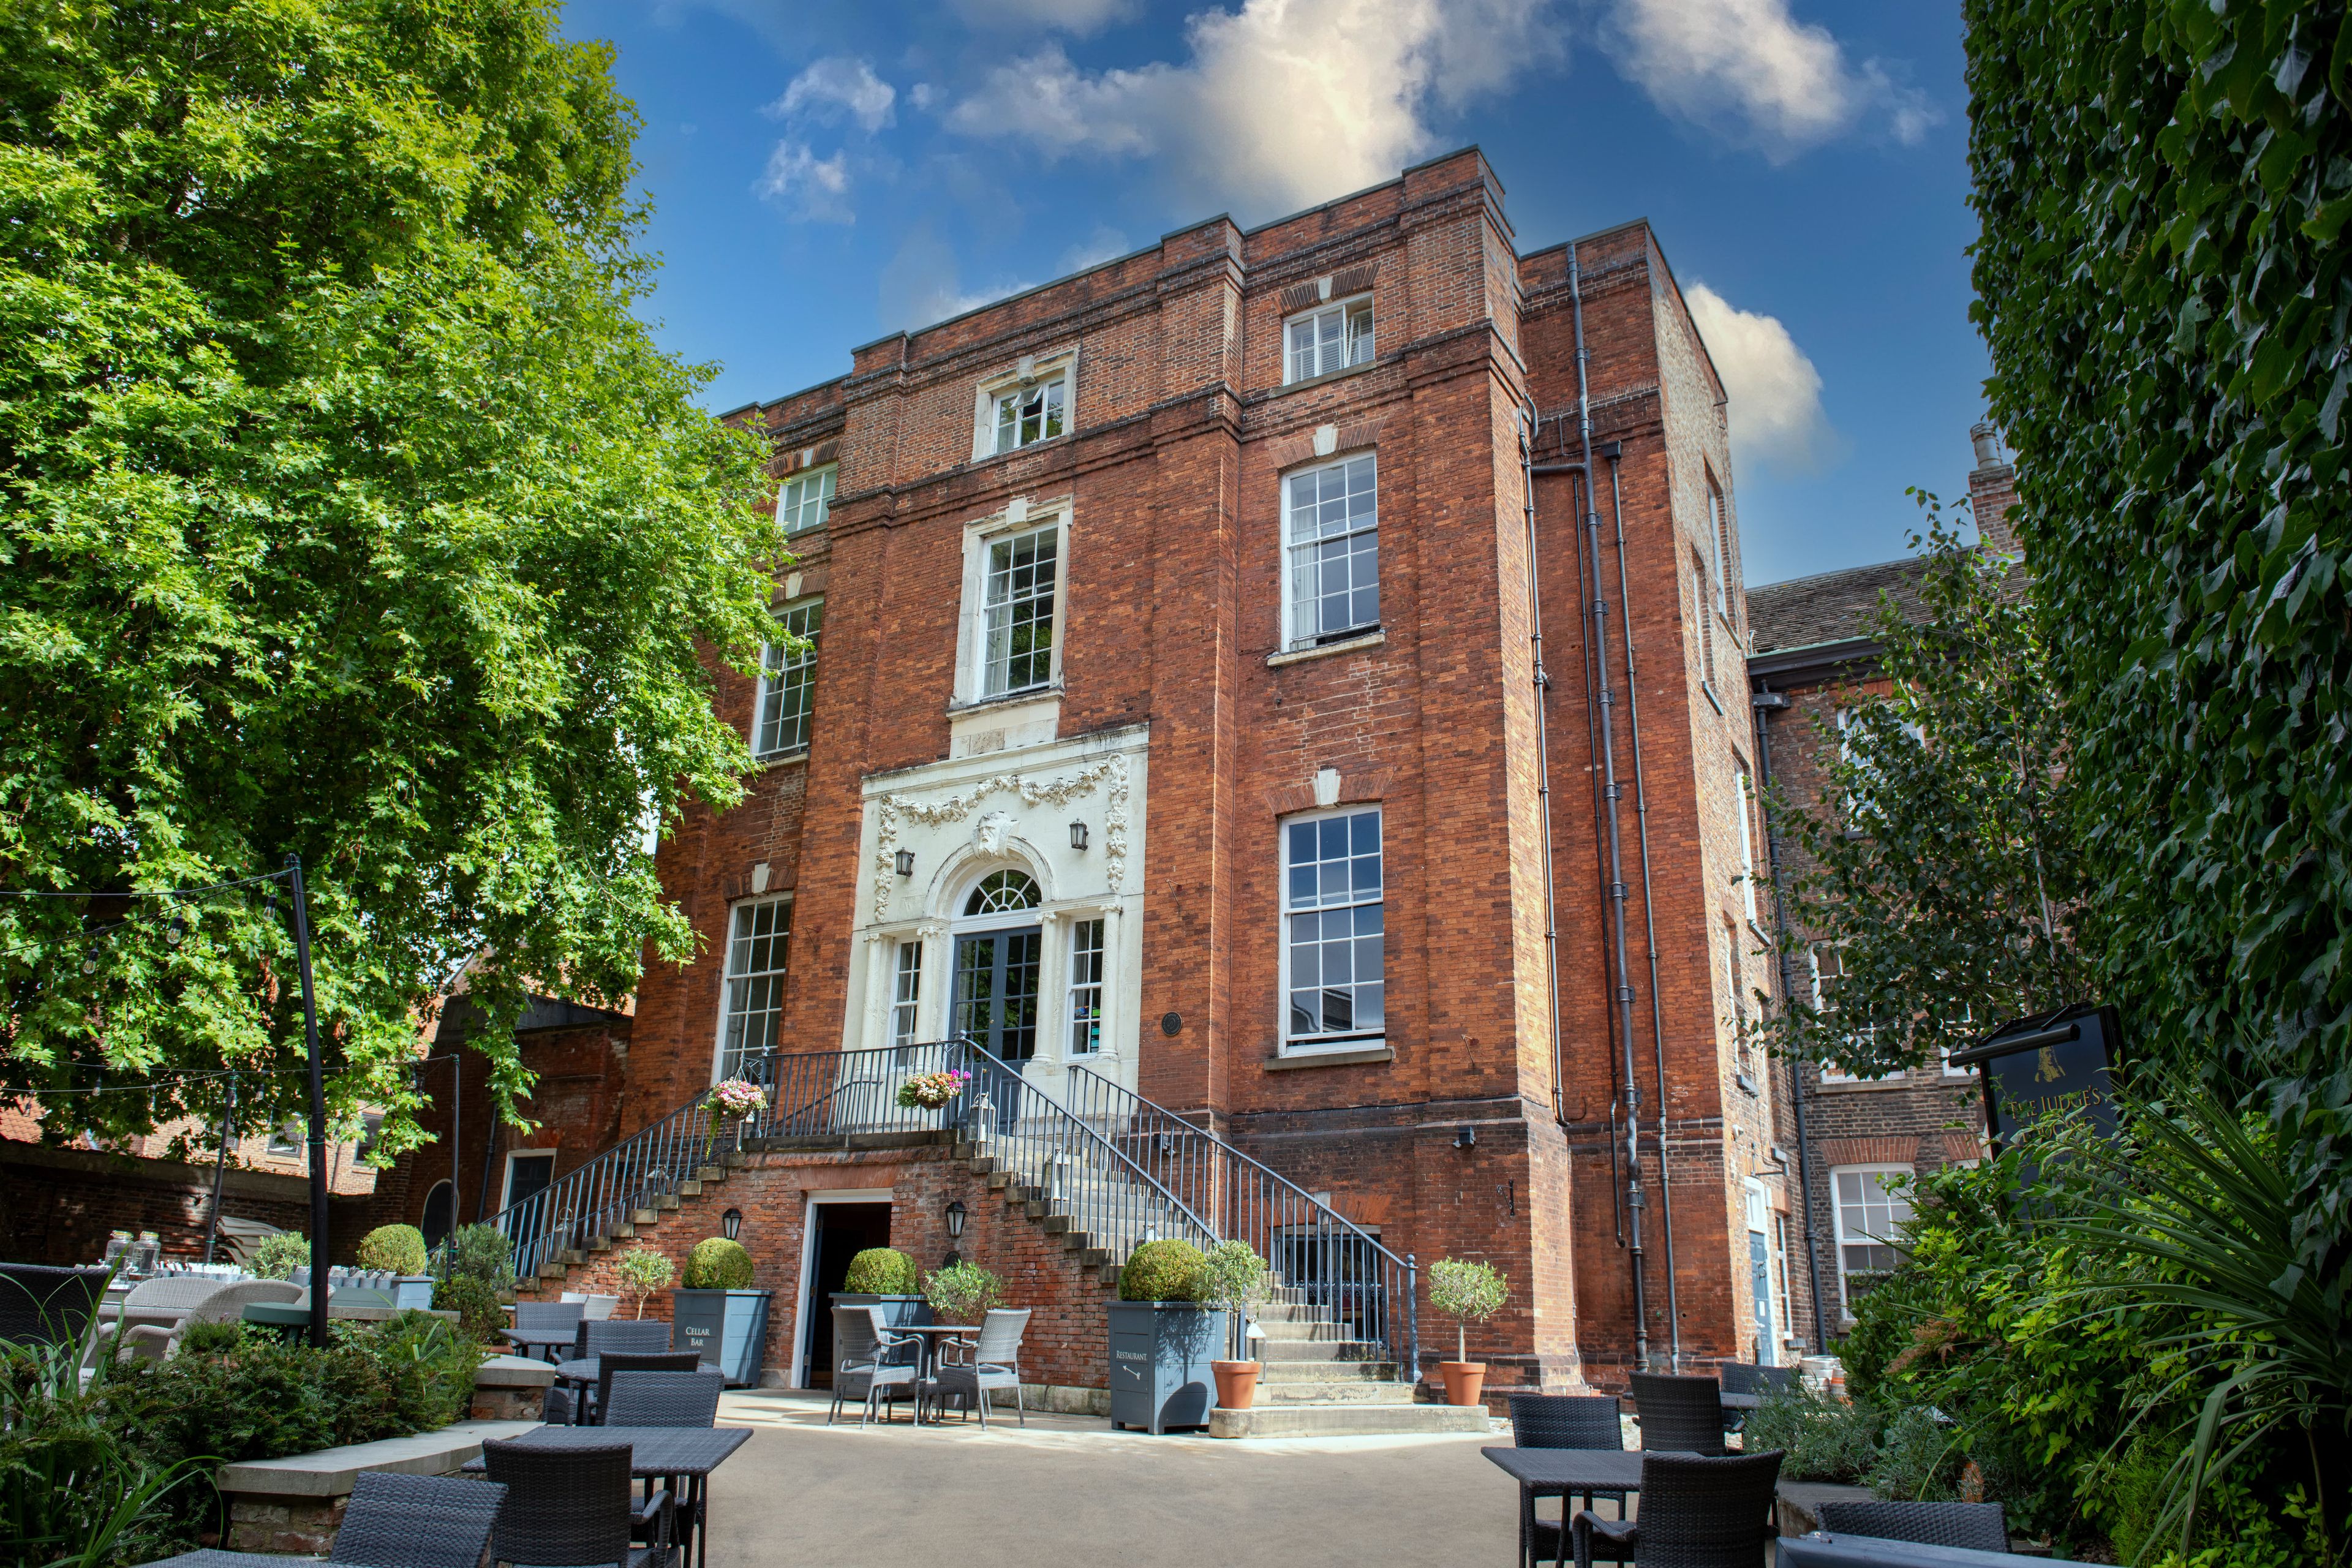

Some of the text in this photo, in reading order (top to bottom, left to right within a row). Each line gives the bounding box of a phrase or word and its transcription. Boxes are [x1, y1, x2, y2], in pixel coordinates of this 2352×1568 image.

[685, 1326, 710, 1335] CELLAR
[691, 1338, 704, 1346] BAR
[1116, 1350, 1147, 1361] RESTAURANT
